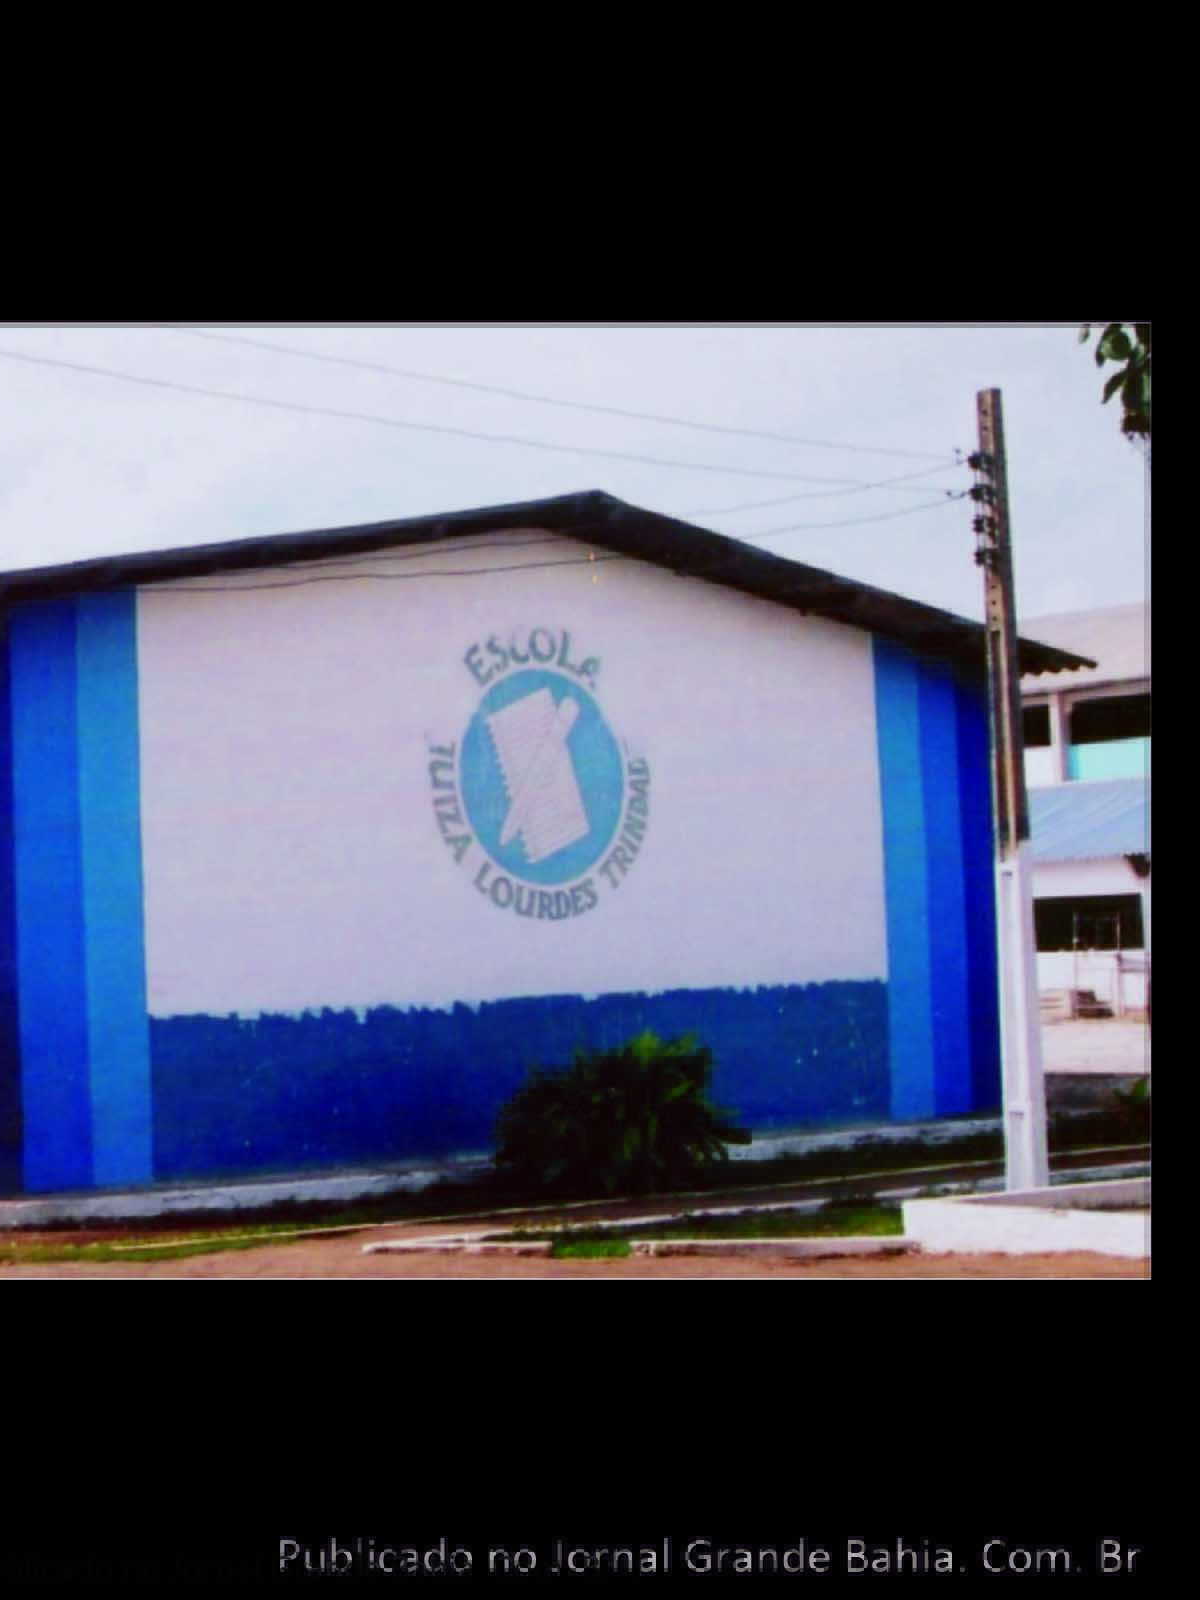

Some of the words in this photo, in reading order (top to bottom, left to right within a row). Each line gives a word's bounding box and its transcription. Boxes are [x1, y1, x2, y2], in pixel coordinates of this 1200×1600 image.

[464, 628, 600, 688] ESCOLA
[472, 861, 599, 920] LOURDES
[599, 740, 649, 889] TRINDAD
